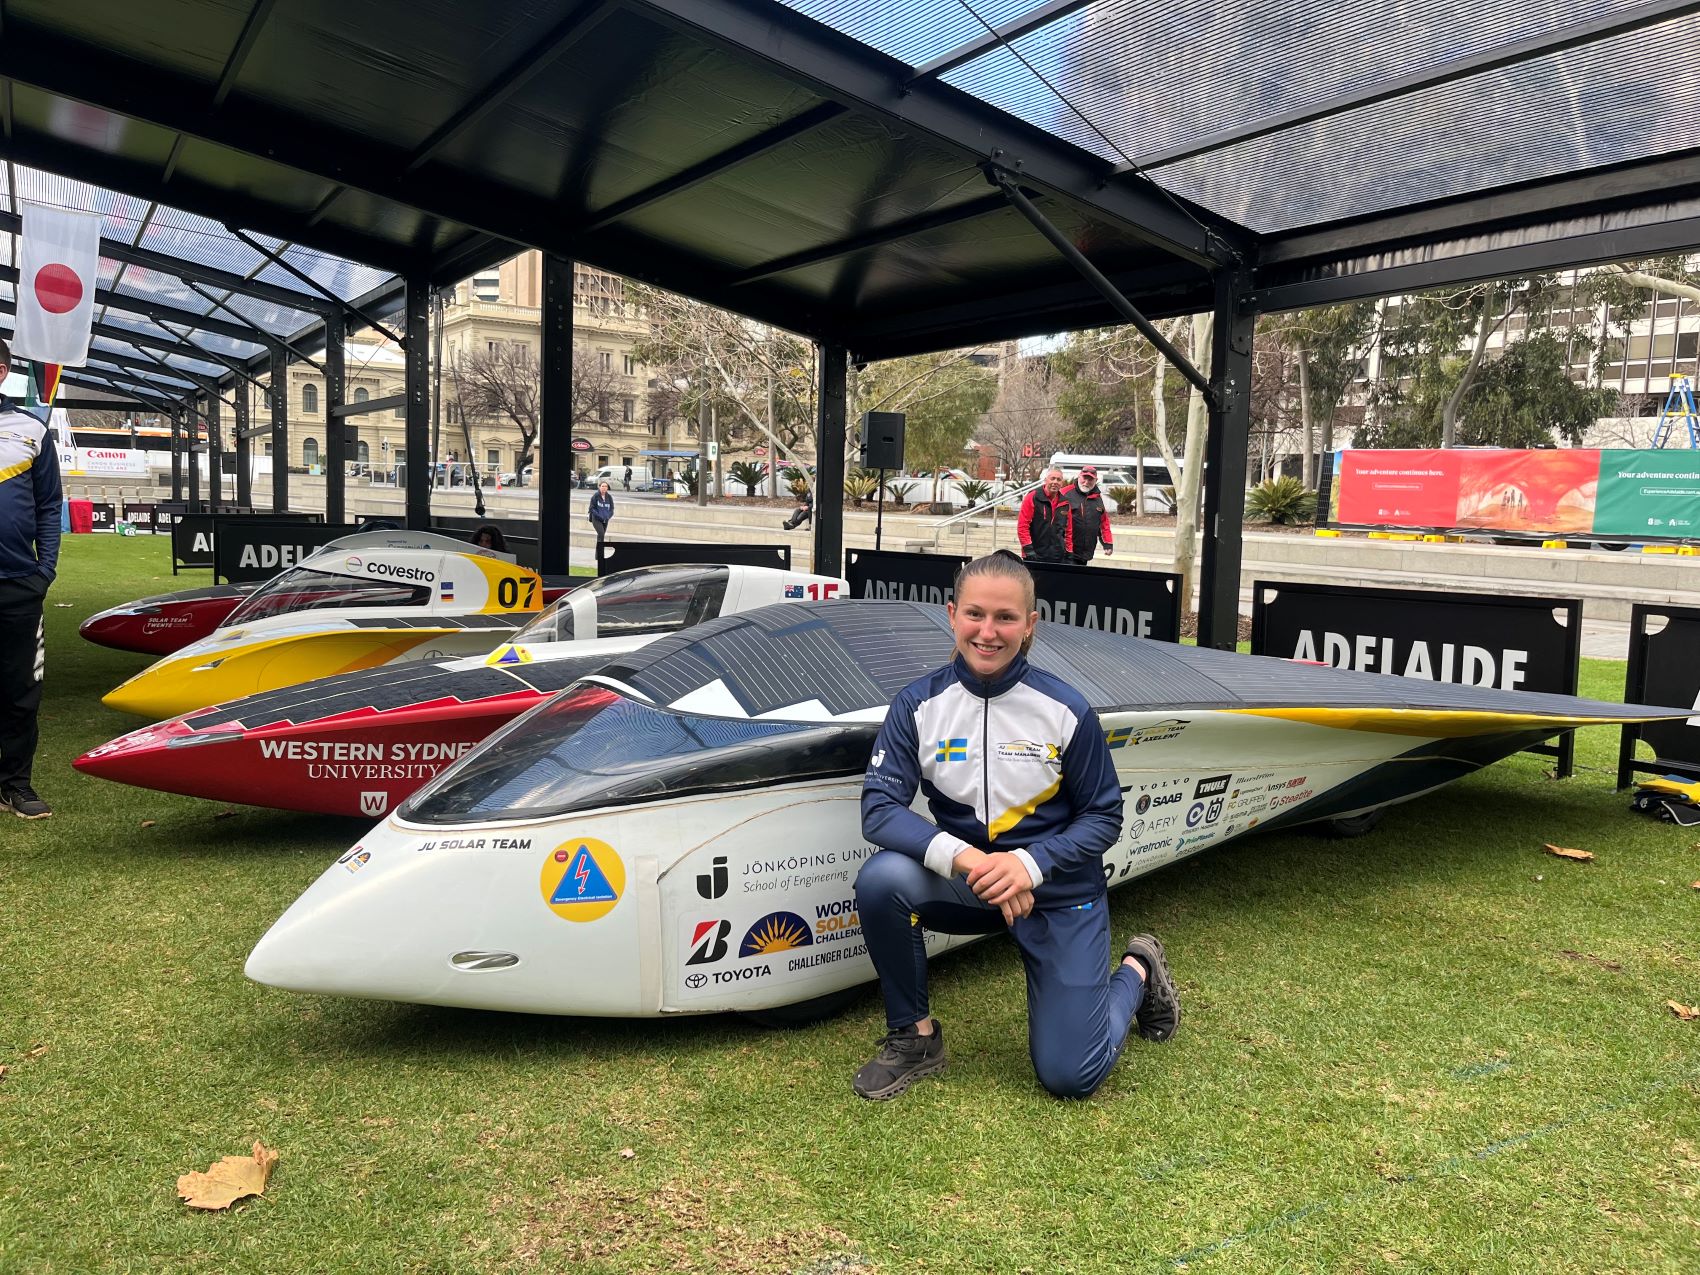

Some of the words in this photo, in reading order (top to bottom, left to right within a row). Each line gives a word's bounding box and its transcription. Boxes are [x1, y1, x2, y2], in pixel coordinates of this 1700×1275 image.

[87, 449, 127, 459] Canon
[1369, 468, 1399, 476] adventure
[1618, 471, 1636, 479] Your
[1675, 472, 1700, 480] contin
[128, 511, 150, 523] ADELAIDE
[240, 544, 321, 568] ADEL
[367, 561, 435, 583] covestro
[498, 577, 538, 609] 07
[1293, 630, 1529, 691] ADELAIDE
[1142, 733, 1181, 743] AXELENT
[259, 739, 384, 761] WESTERN
[390, 742, 481, 761] SYDNE
[308, 764, 442, 779] UNIVERSITY
[1139, 777, 1190, 792] VOLVO
[1199, 779, 1227, 794] THULE
[363, 795, 385, 811] W
[1152, 792, 1183, 808] SAAB
[1146, 815, 1178, 832] AFRY
[417, 841, 437, 852] JU
[439, 838, 487, 851] SOLAR
[491, 838, 532, 850] TEAM
[1129, 837, 1173, 857] wiretronic
[742, 852, 836, 875] JÖNKÖPING
[743, 874, 777, 893] School
[780, 874, 792, 890] of
[793, 869, 849, 888] Engineering
[788, 947, 842, 972] CHALLENGER
[843, 942, 869, 960] CLASS
[712, 964, 772, 985] TOYOTA
